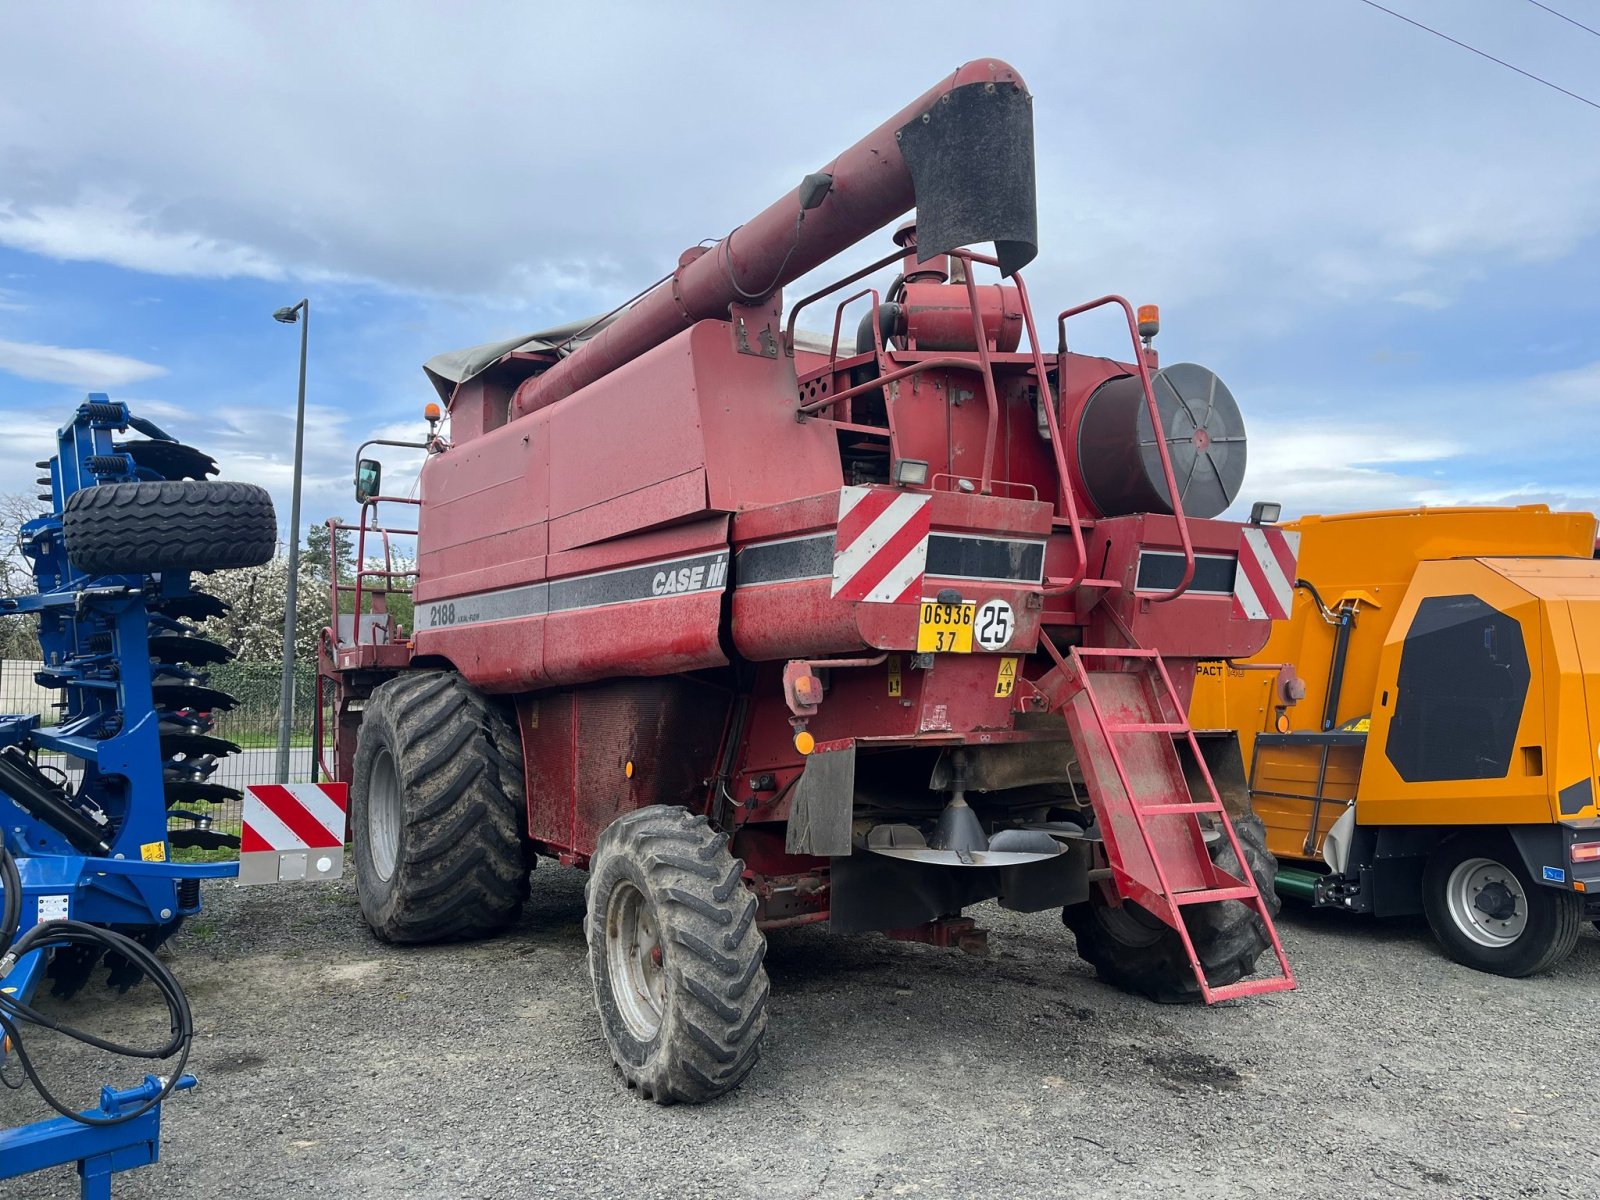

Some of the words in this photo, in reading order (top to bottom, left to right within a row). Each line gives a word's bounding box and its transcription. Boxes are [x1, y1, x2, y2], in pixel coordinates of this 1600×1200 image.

[652, 565, 706, 596] CASE
[430, 602, 455, 627] 2188
[924, 604, 971, 625] 06936
[980, 606, 1009, 643] 25
[936, 631, 956, 651] 37
[1196, 666, 1223, 676] PACT
